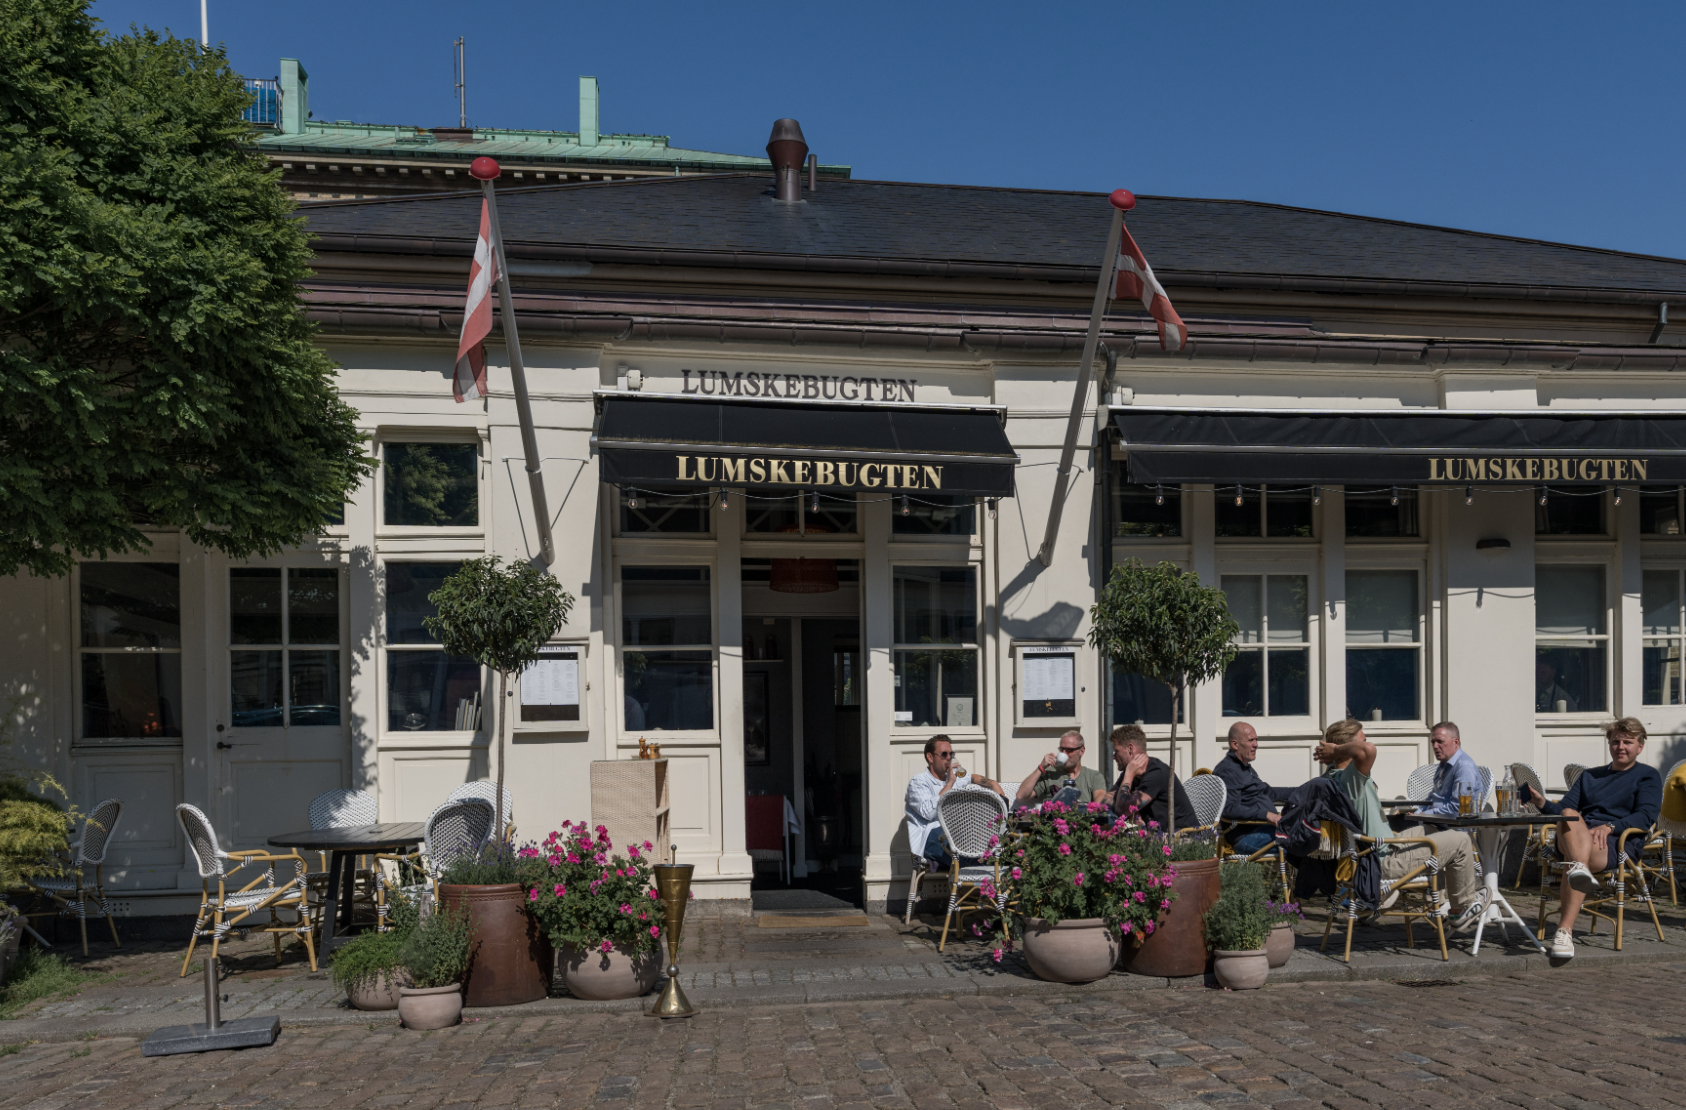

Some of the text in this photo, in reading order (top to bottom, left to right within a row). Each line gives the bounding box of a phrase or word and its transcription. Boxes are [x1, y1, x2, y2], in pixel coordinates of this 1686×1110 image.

[682, 369, 917, 403] LUMSKEBUGTEN
[676, 455, 944, 490] LUMSKEBUGTEN
[1428, 458, 1648, 481] LUMSKEBUGTEN
